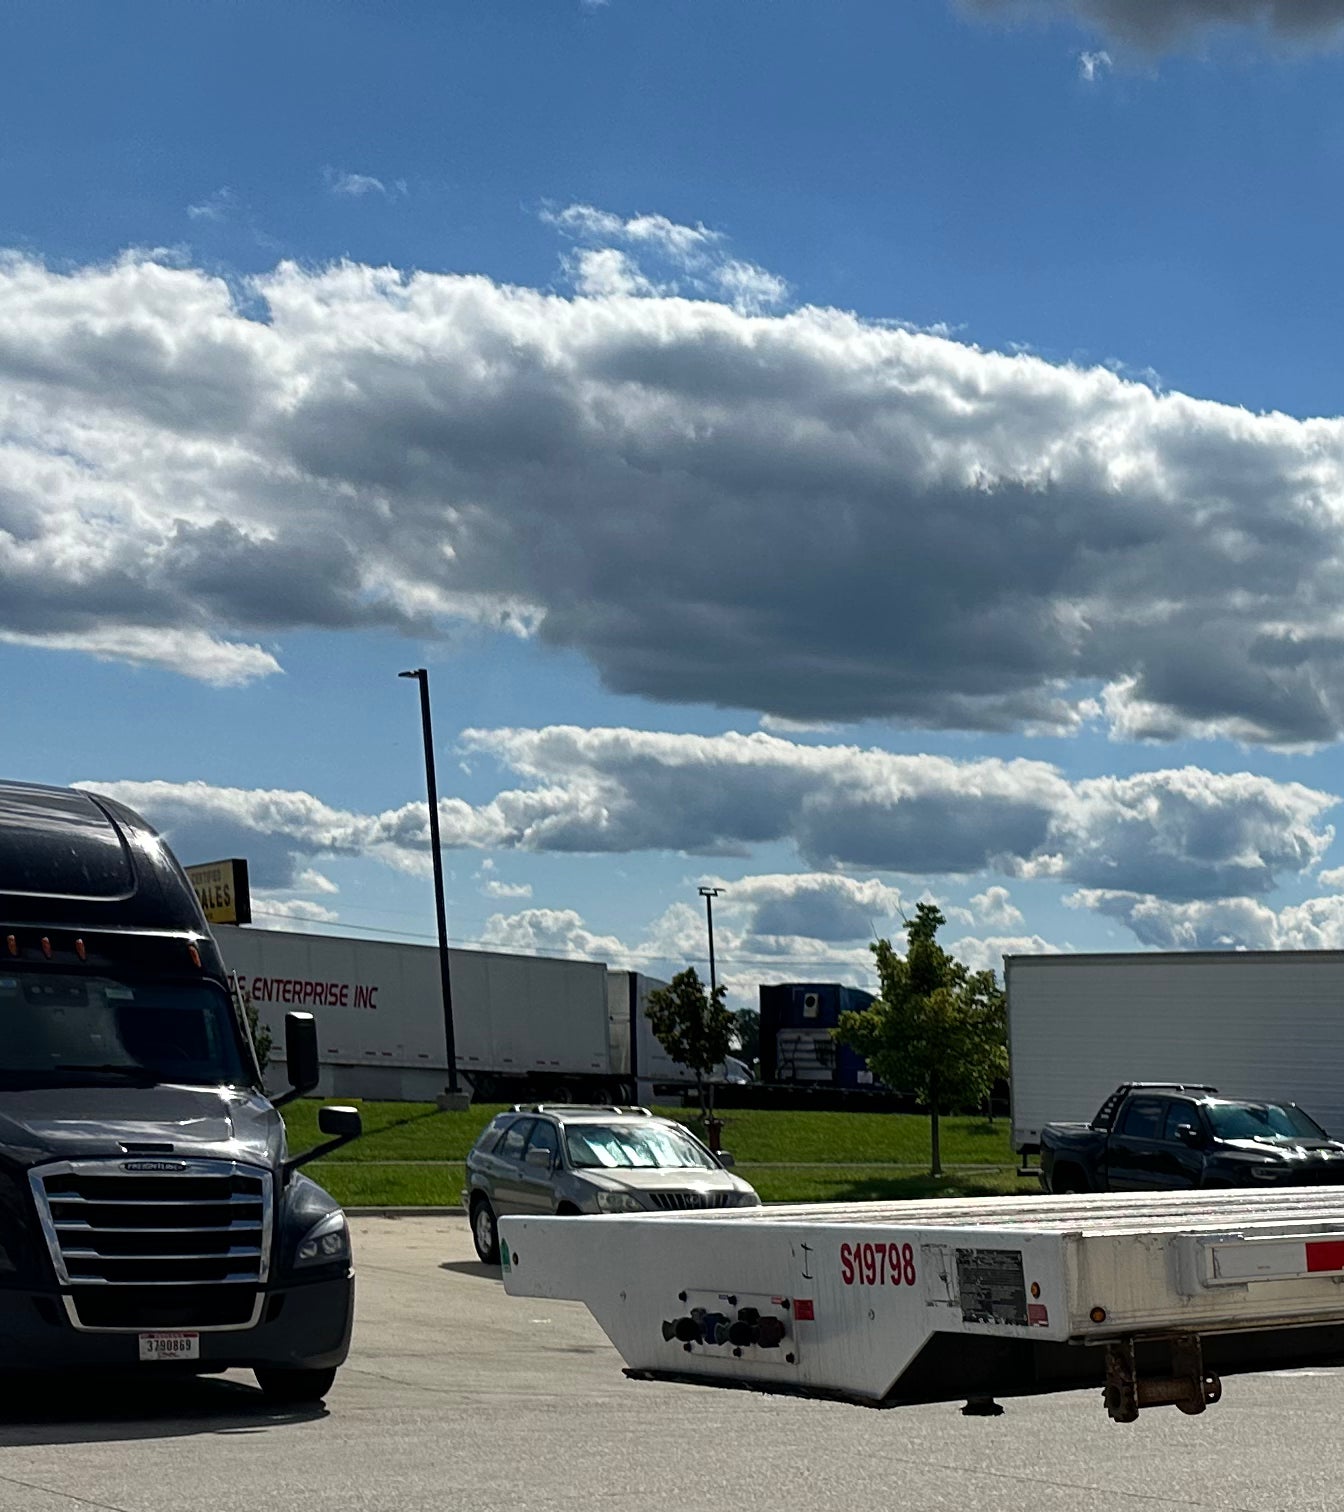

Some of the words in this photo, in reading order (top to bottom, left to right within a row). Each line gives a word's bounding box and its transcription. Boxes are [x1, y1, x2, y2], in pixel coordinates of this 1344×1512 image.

[251, 975, 350, 1007] ENTERPRISE
[353, 984, 379, 1010] INC
[840, 1242, 917, 1287] S19798
[146, 1339, 192, 1352] 3790869
